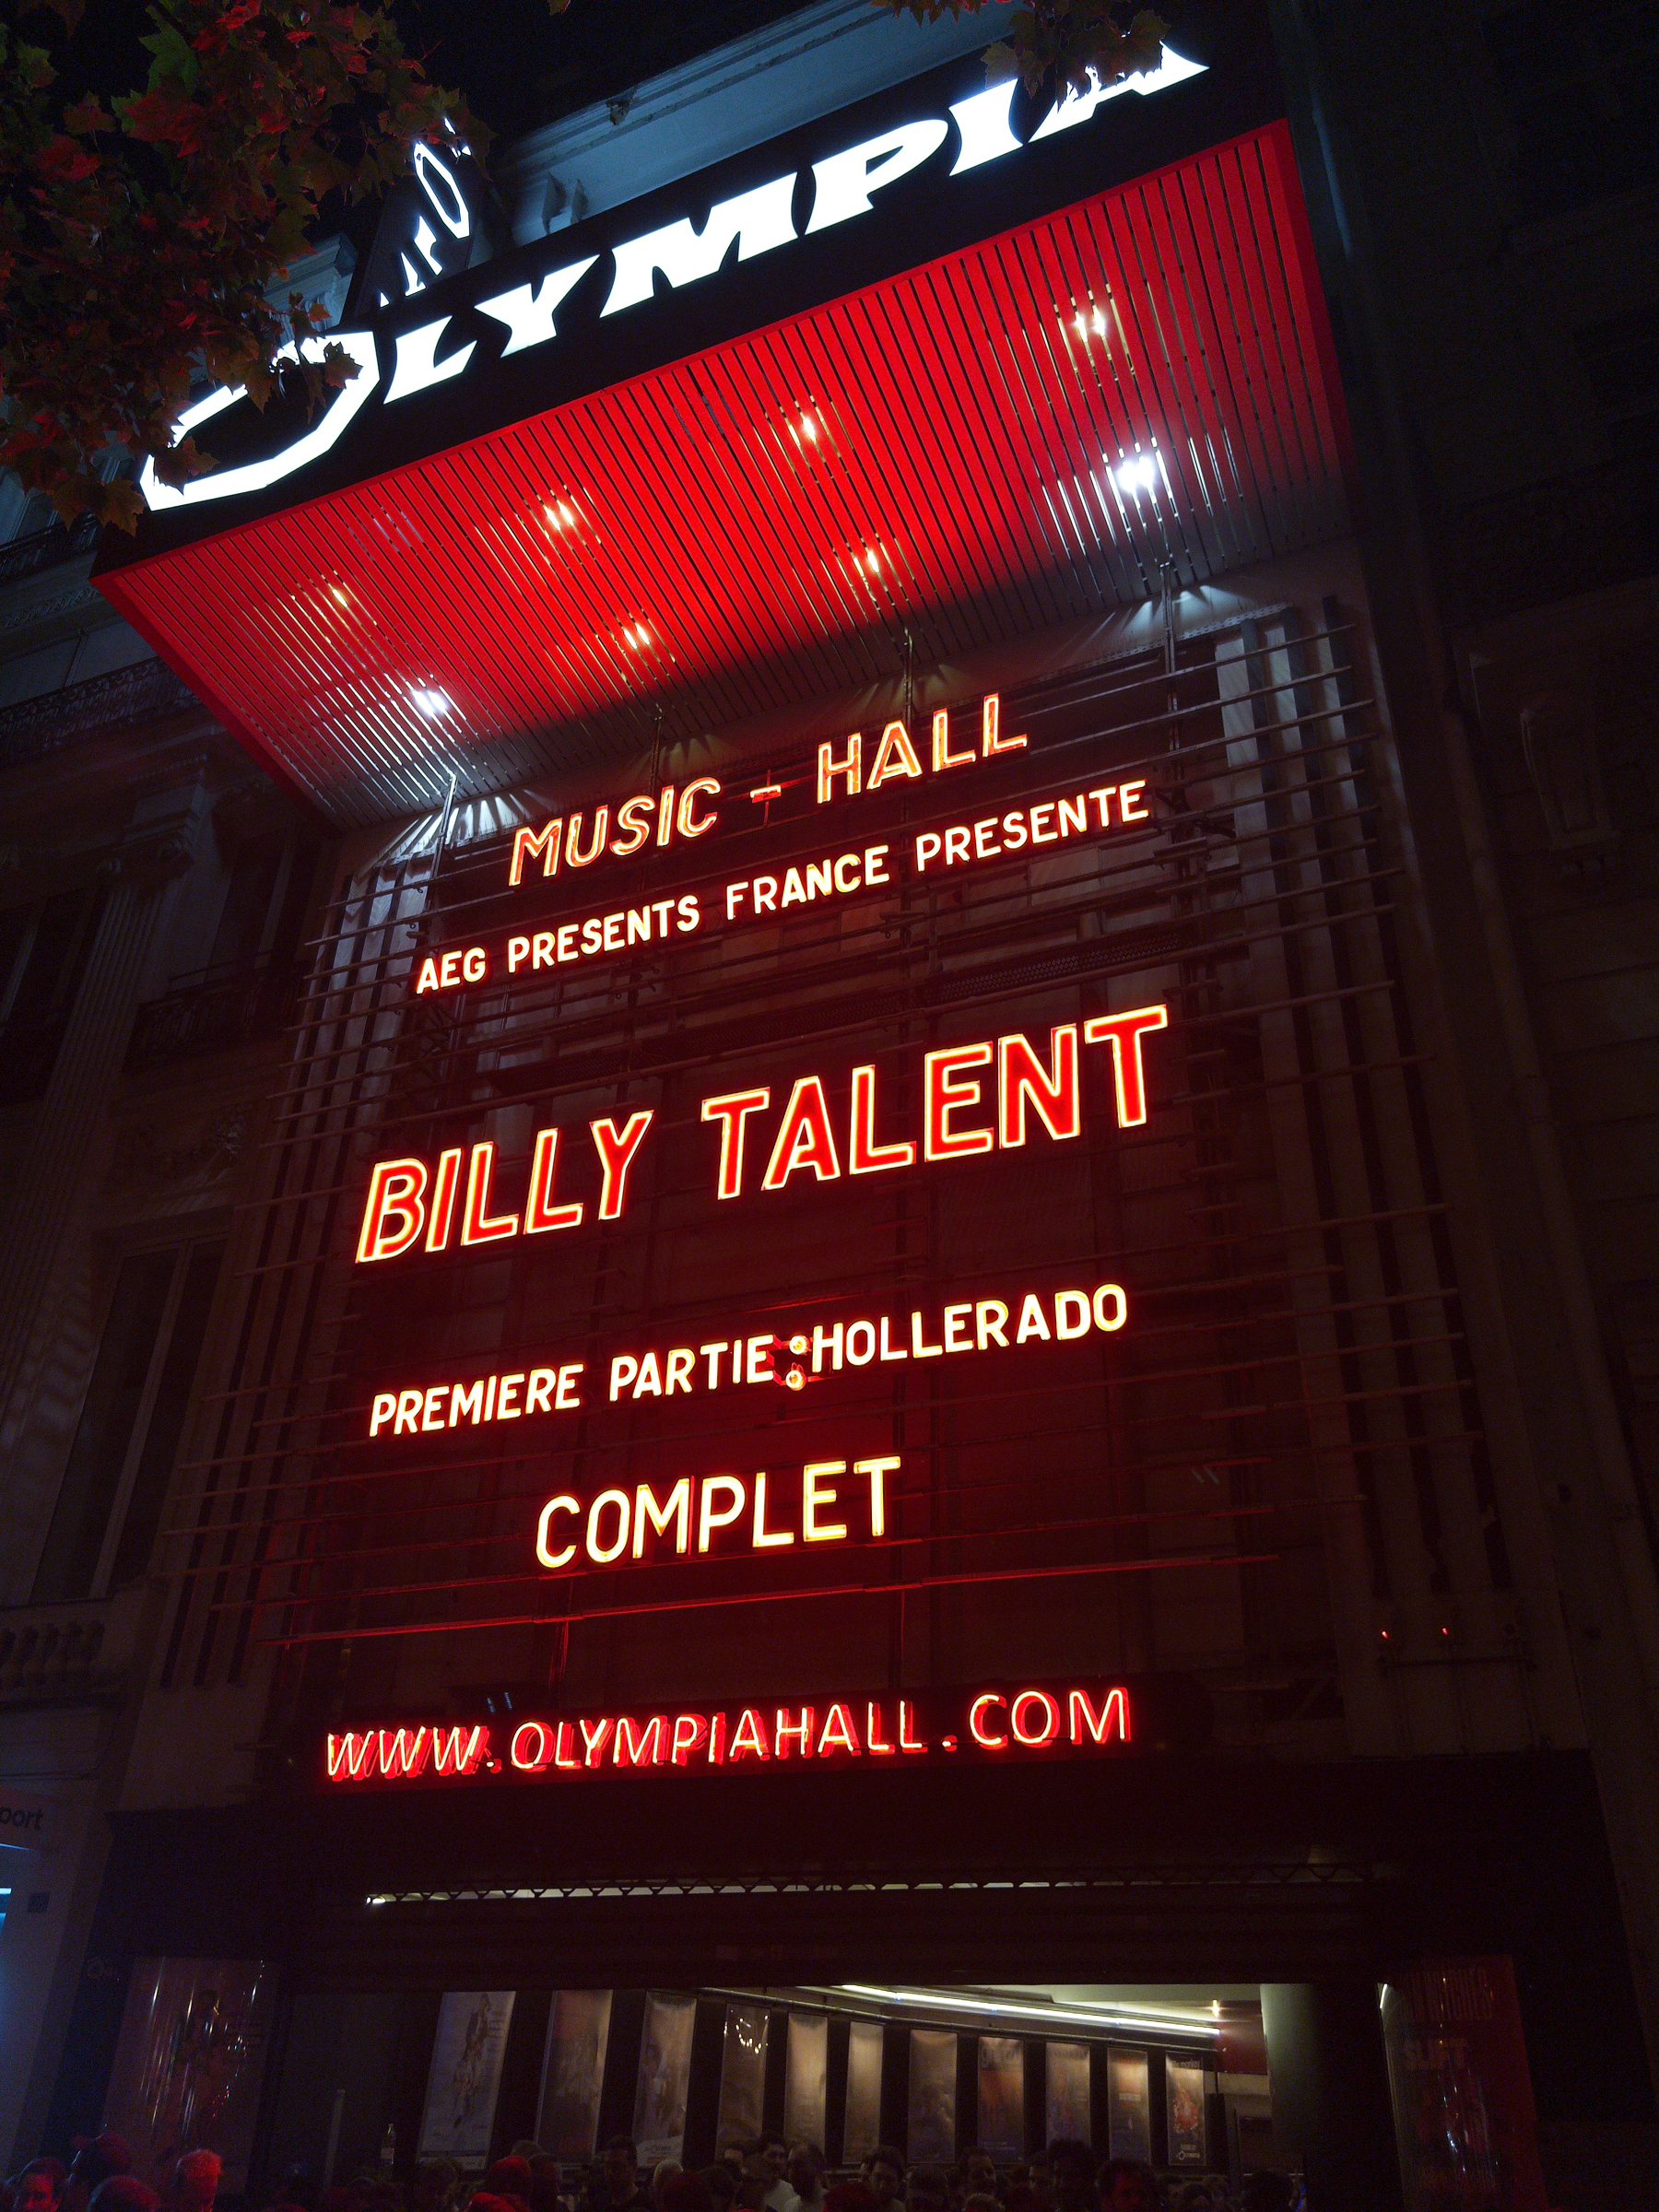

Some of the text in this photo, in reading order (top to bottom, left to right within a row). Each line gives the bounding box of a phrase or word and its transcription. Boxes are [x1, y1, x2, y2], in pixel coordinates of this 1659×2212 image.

[508, 776, 722, 886] MUSIC
[817, 692, 1028, 805] HALL
[415, 778, 1149, 995] AEG PRESENTS FRANCE PRESENTE
[355, 1004, 1169, 1265] BILLY TALENT
[369, 1362, 584, 1438] PREMIERE
[535, 1455, 901, 1569] COMPLET
